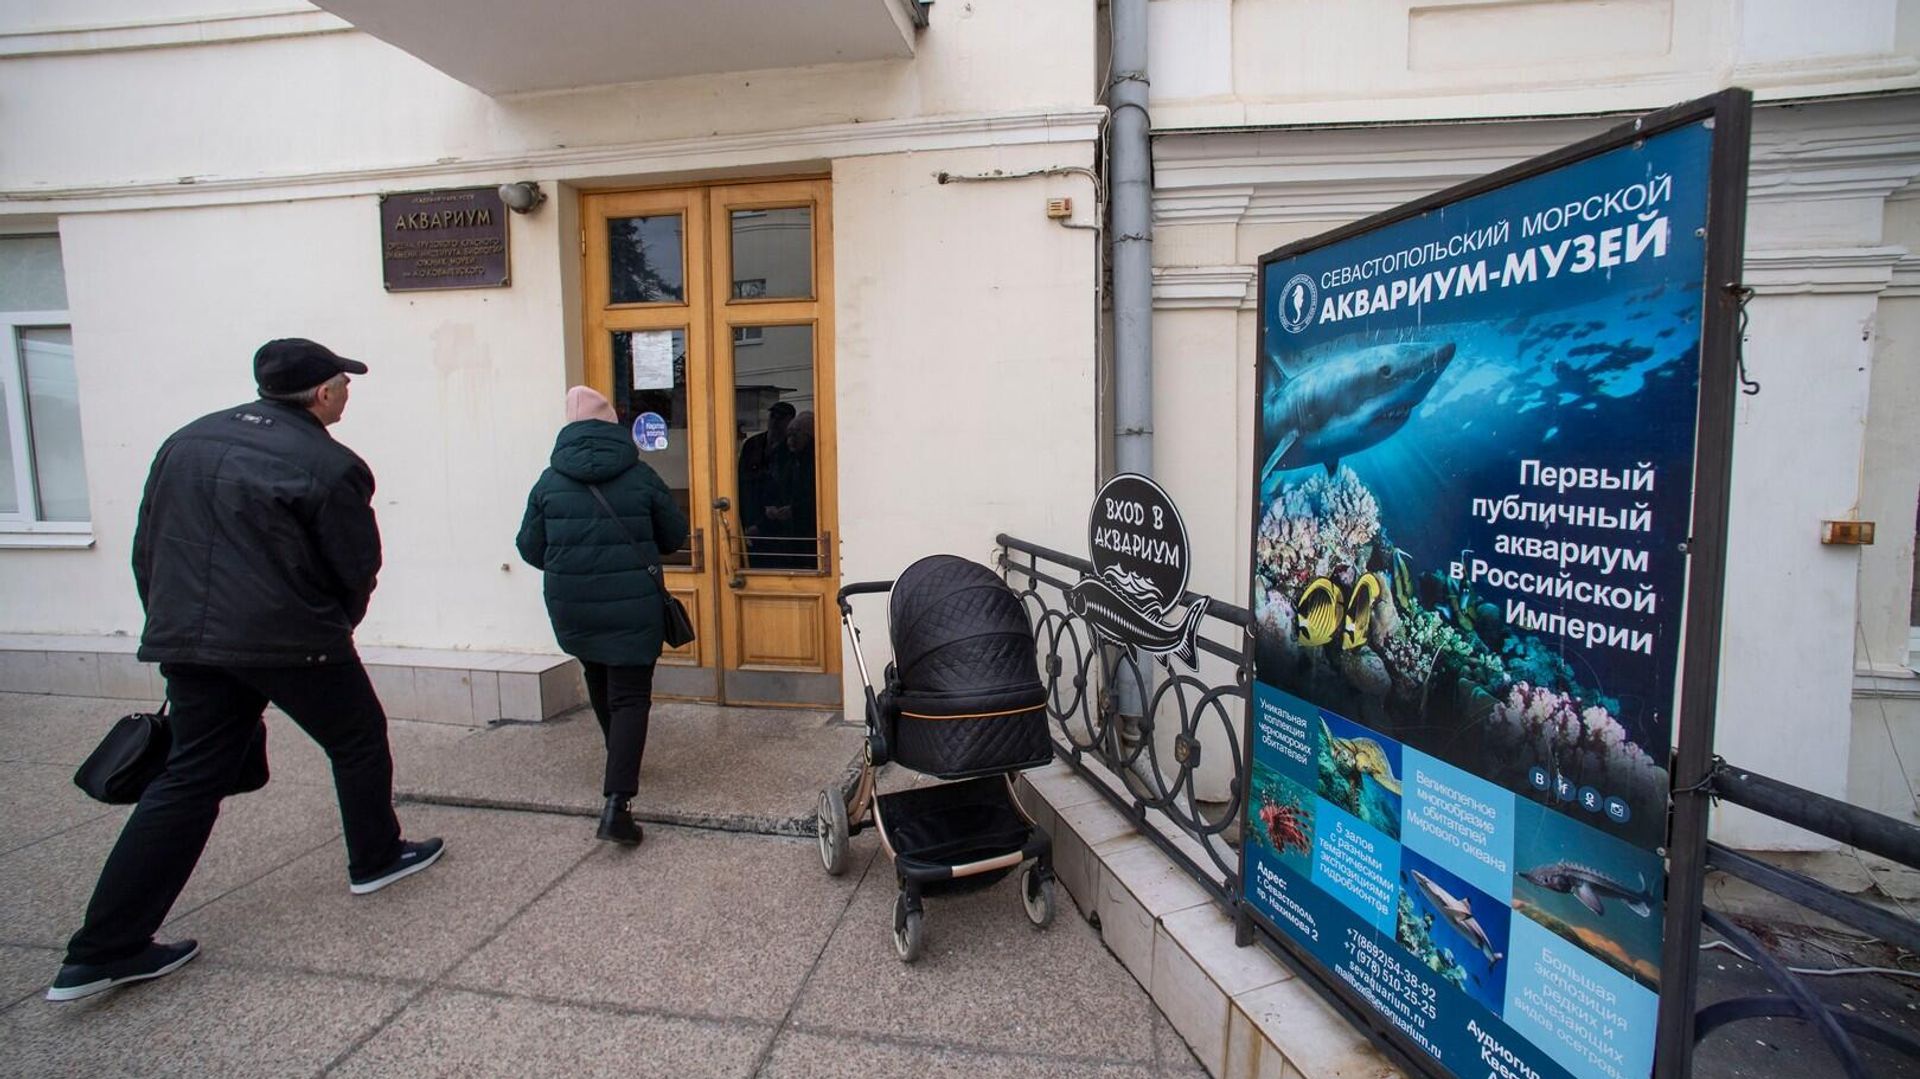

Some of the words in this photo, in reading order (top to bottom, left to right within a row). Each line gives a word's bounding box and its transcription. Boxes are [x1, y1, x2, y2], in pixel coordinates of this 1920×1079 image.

[395, 209, 493, 231] АКВАРИУМ
[1320, 218, 1510, 290] СЕВАСТОПОЛЬСКИЙ
[1521, 173, 1673, 238] МОРСКОЙ
[1318, 209, 1669, 325] АКВАРИУМ-МУЗЕЙ
[1519, 459, 1655, 494] Первый
[1105, 497, 1145, 527] ВХОД
[1152, 505, 1164, 531] В
[1471, 493, 1652, 532] публичный
[1094, 526, 1180, 569] АКВАРИУМ
[1494, 533, 1650, 575] аквариум
[1450, 561, 1464, 580] в
[1471, 559, 1657, 615] Российской
[1505, 598, 1653, 655] Империи
[1259, 696, 1308, 729] Уникальная
[1263, 713, 1306, 740] коллекция
[1258, 721, 1312, 757] черноморских
[1416, 769, 1496, 819] Великолепное
[1416, 788, 1495, 834] многообразие
[1335, 821, 1343, 834] 5
[1344, 828, 1374, 854] залов
[1406, 808, 1460, 847] Мирового
[1462, 841, 1507, 872] океана
[1423, 806, 1487, 846] обитателей
[1319, 837, 1394, 893] тематическими
[1329, 832, 1337, 842] с
[1337, 837, 1382, 871] разными
[1320, 850, 1391, 904] экспозициями
[1320, 863, 1389, 916] гидробионтов
[1269, 895, 1310, 935] Нахимова
[1311, 928, 1319, 942] 2
[1348, 960, 1425, 1029] sevaquarium.ru
[1356, 948, 1381, 978] (978)
[1381, 968, 1437, 1020] 510-25-25
[1542, 947, 1617, 1006] Большая
[1513, 996, 1554, 1031] видов
[1523, 986, 1624, 1066] исчезающих
[1542, 984, 1599, 1029] редких
[1603, 1024, 1614, 1040] и
